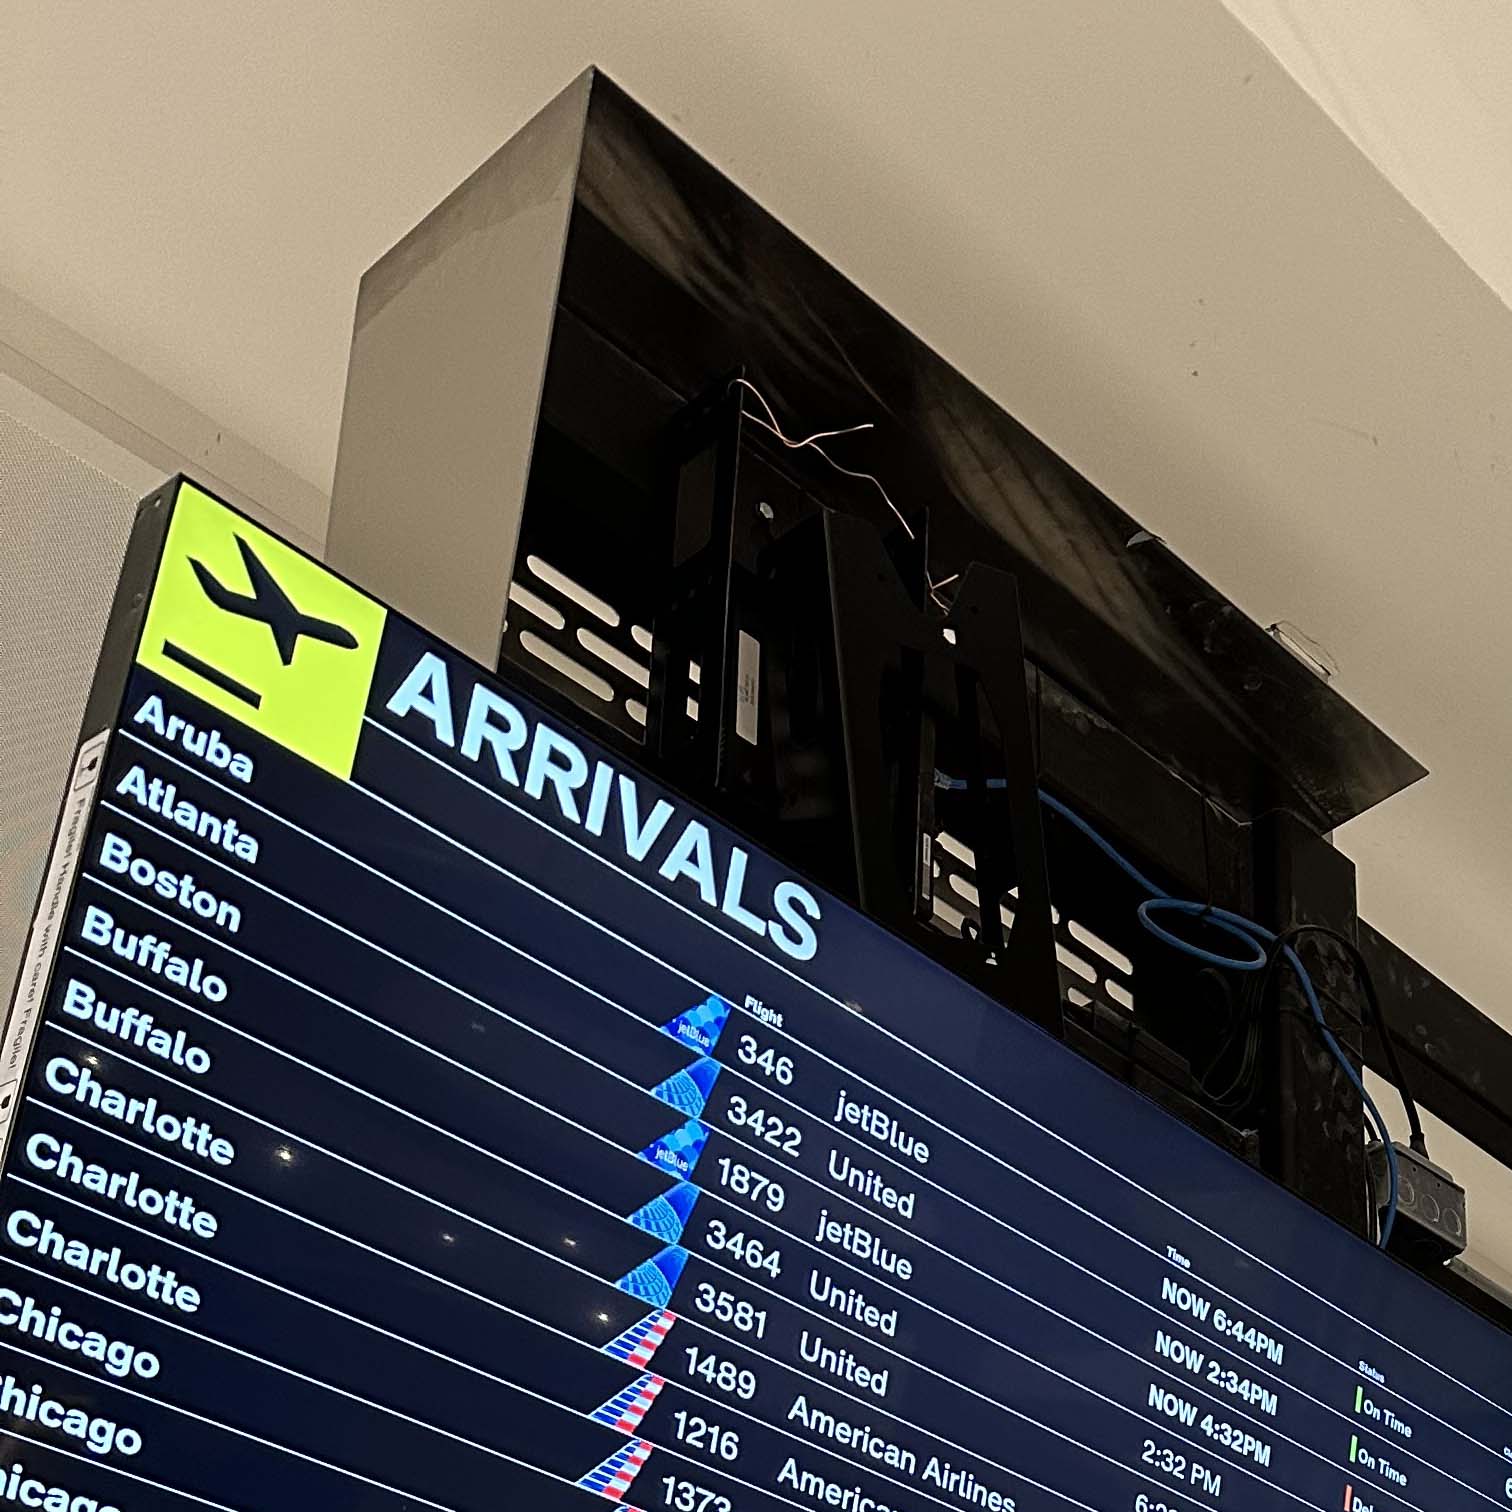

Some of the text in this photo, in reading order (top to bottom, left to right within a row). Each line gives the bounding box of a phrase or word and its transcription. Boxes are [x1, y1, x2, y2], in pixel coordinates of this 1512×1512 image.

[132, 695, 255, 784] Aruba
[115, 765, 259, 865] Atlanta
[385, 651, 821, 962] ARRIVALS
[98, 832, 242, 934] Boston
[80, 904, 228, 1003] Buffalo
[62, 978, 211, 1075] Buffalo
[744, 995, 783, 1029] Flight
[737, 1034, 794, 1086] 346
[44, 1055, 235, 1167] Charlotte
[726, 1095, 802, 1159] 3422
[833, 1089, 930, 1164] jetBlue
[25, 1132, 218, 1239] Charlotte
[717, 1157, 785, 1213] 1879
[828, 1149, 915, 1220] United
[5, 1209, 201, 1314] Charlotte
[705, 1219, 781, 1279] 3464
[814, 1208, 913, 1281] jetBlue
[0, 1287, 161, 1380] Chicago
[694, 1282, 767, 1340] 3581
[809, 1269, 898, 1338] United
[1160, 1277, 1284, 1366] NOW 6:44PM
[684, 1346, 756, 1400] 1489
[799, 1330, 889, 1398] United
[1154, 1329, 1278, 1417] NOW 2:34PM
[673, 1410, 740, 1461] 1216
[787, 1395, 916, 1476] American
[1147, 1383, 1271, 1468] NOW 4:32PM
[1362, 1398, 1412, 1439] On Time
[1141, 1439, 1221, 1497] 2:32 PM
